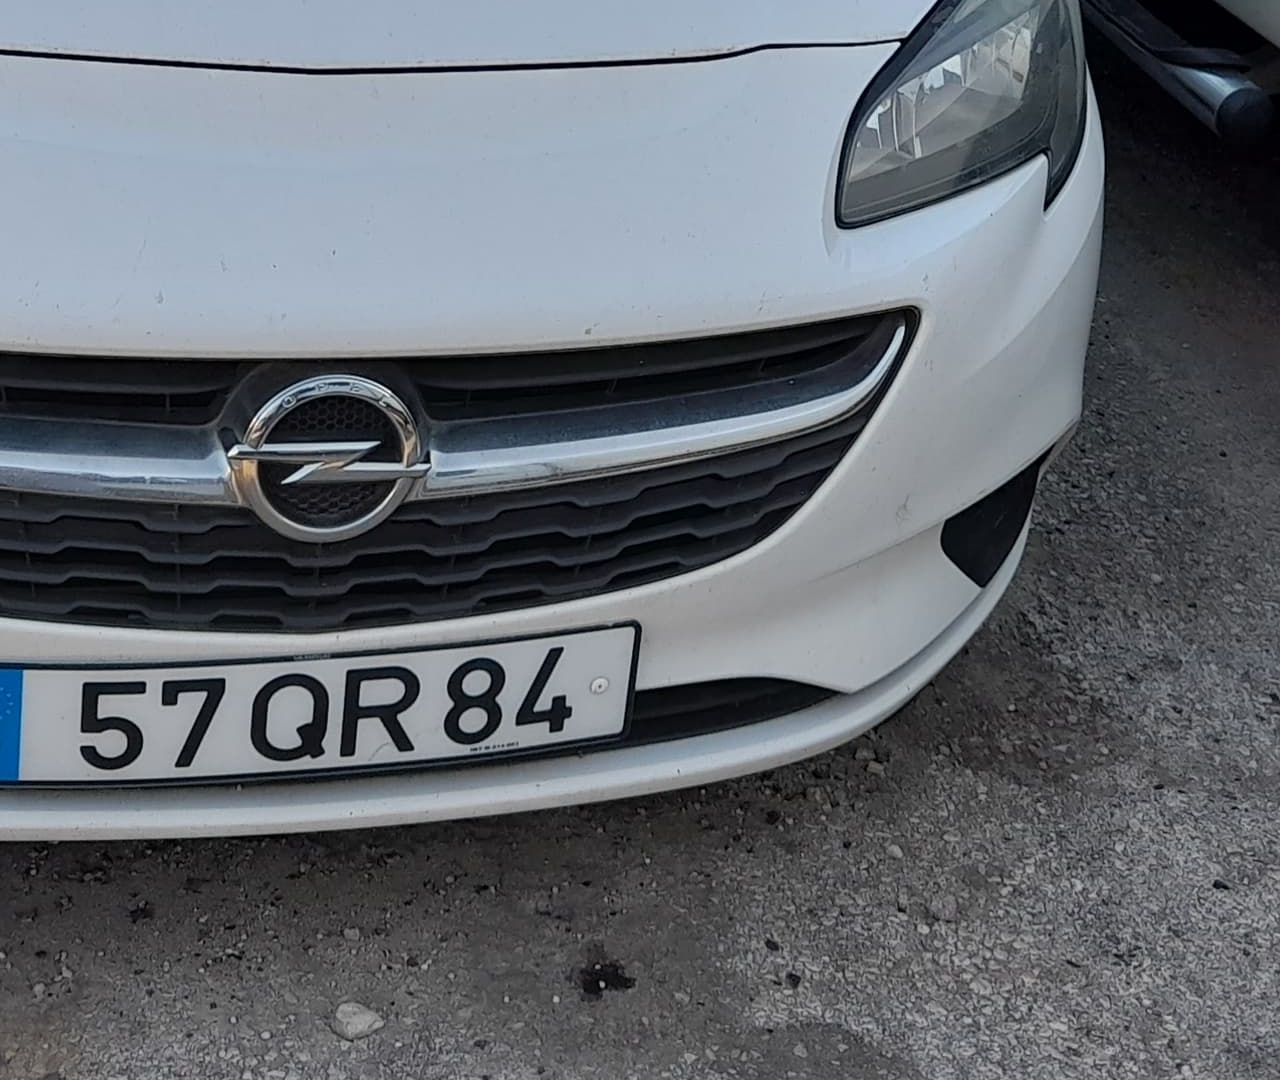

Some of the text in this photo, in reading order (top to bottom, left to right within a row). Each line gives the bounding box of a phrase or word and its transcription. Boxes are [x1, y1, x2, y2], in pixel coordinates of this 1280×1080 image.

[79, 646, 573, 771] 57 QR 84
